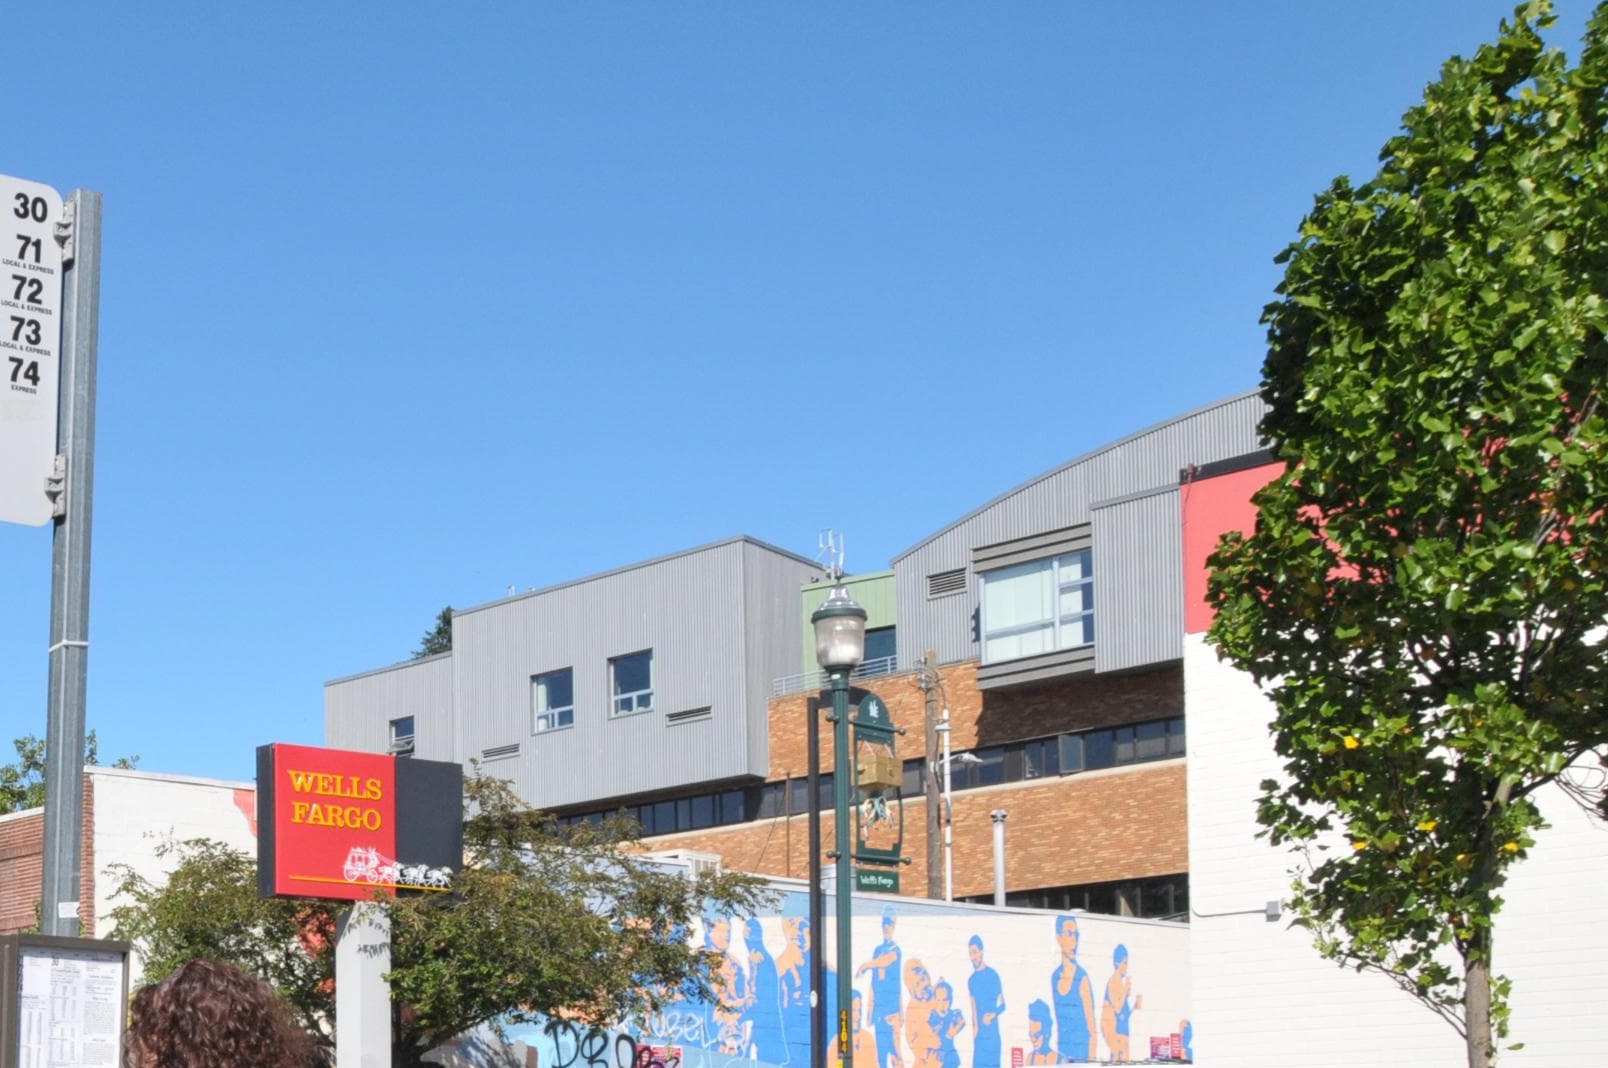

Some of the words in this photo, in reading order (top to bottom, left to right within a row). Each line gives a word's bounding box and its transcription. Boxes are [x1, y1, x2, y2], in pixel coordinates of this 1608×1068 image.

[14, 193, 48, 223] 30
[16, 234, 42, 263] 71
[2, 258, 21, 269] LOCAL
[28, 264, 54, 275] EXPRESS
[12, 274, 44, 305] 72
[1, 300, 20, 310] LOCAL
[27, 305, 53, 316] EXPRESS
[10, 315, 42, 346] 73
[0, 340, 18, 351] LOCAL
[25, 345, 51, 357] EXPRESS
[8, 356, 40, 387] 74
[11, 384, 37, 395] EXPRESS
[287, 769, 383, 801] WELLS
[292, 801, 383, 831] FARGO
[839, 1009, 848, 1053] 4104
